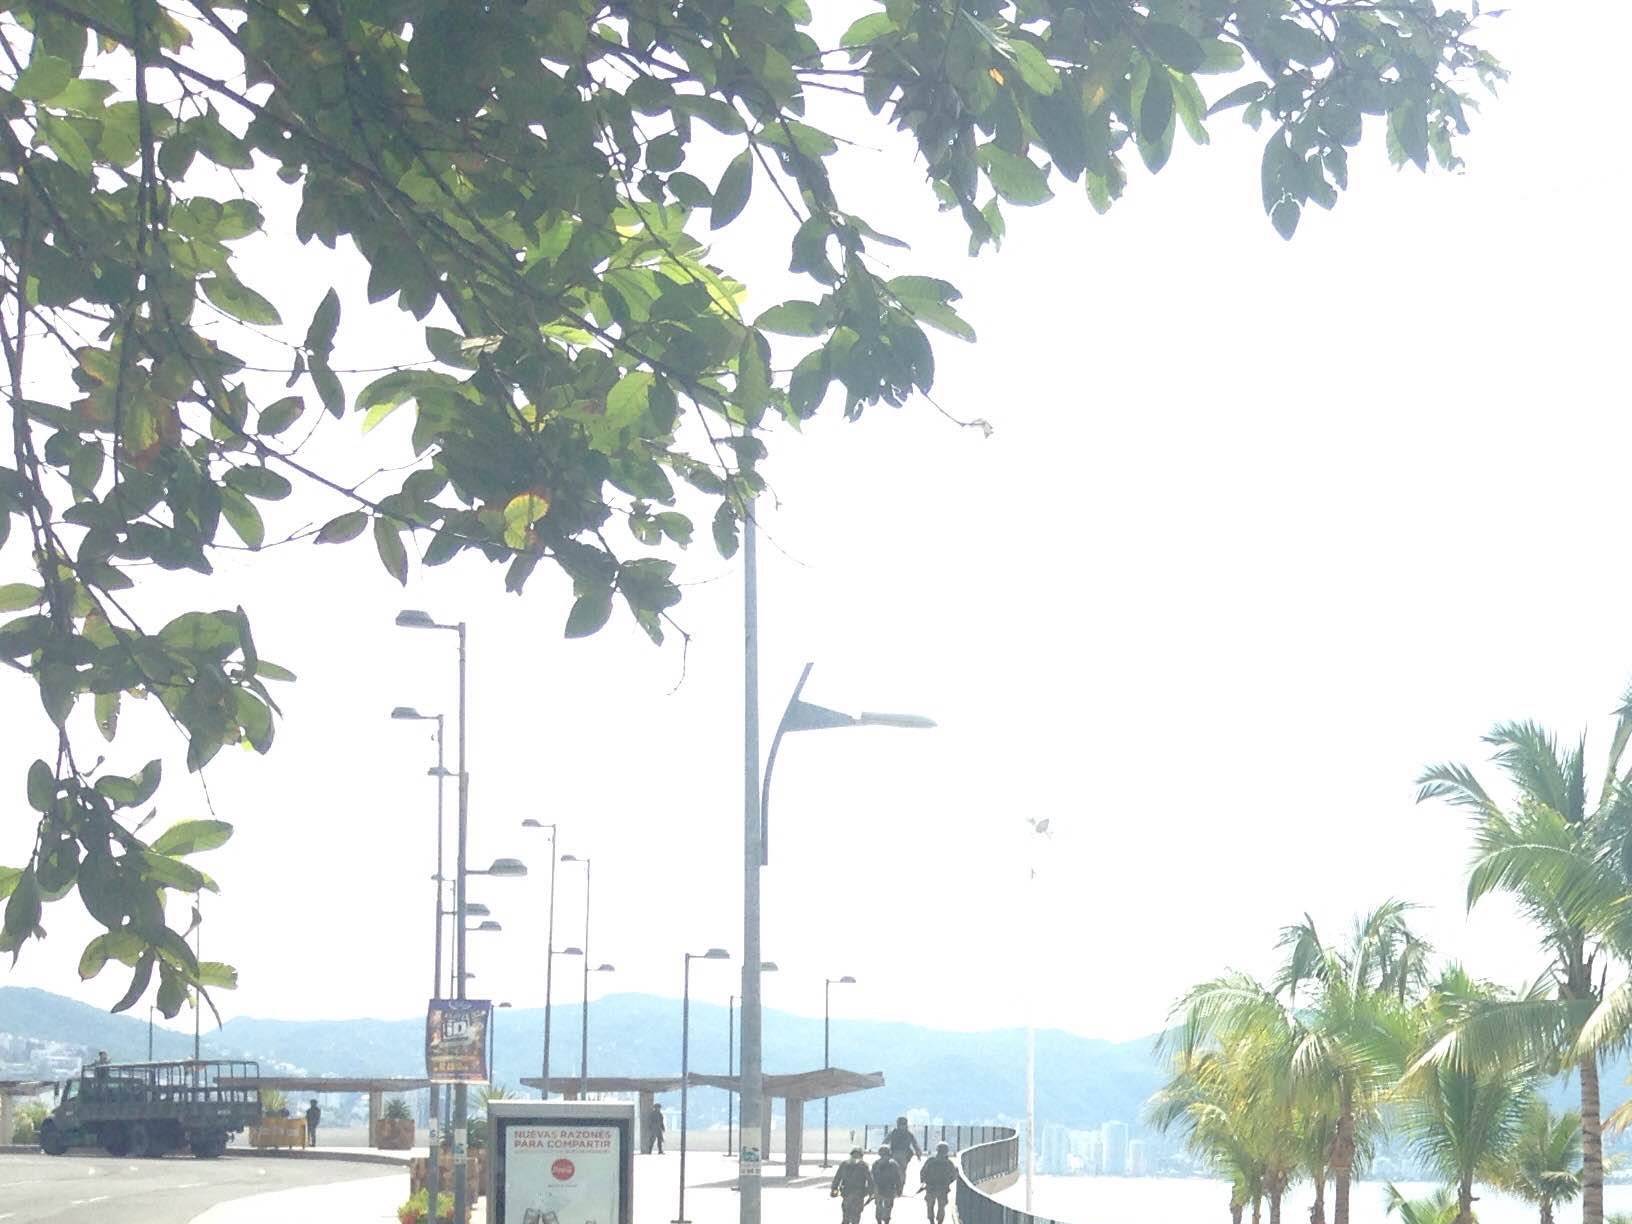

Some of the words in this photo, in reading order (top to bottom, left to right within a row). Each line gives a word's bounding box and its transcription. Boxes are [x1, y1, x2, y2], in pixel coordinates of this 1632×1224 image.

[514, 1130, 558, 1139] NUEVAS
[560, 1130, 612, 1139] RAZONES
[514, 1139, 544, 1148] PARA
[547, 1139, 612, 1149] COMPARTIR
